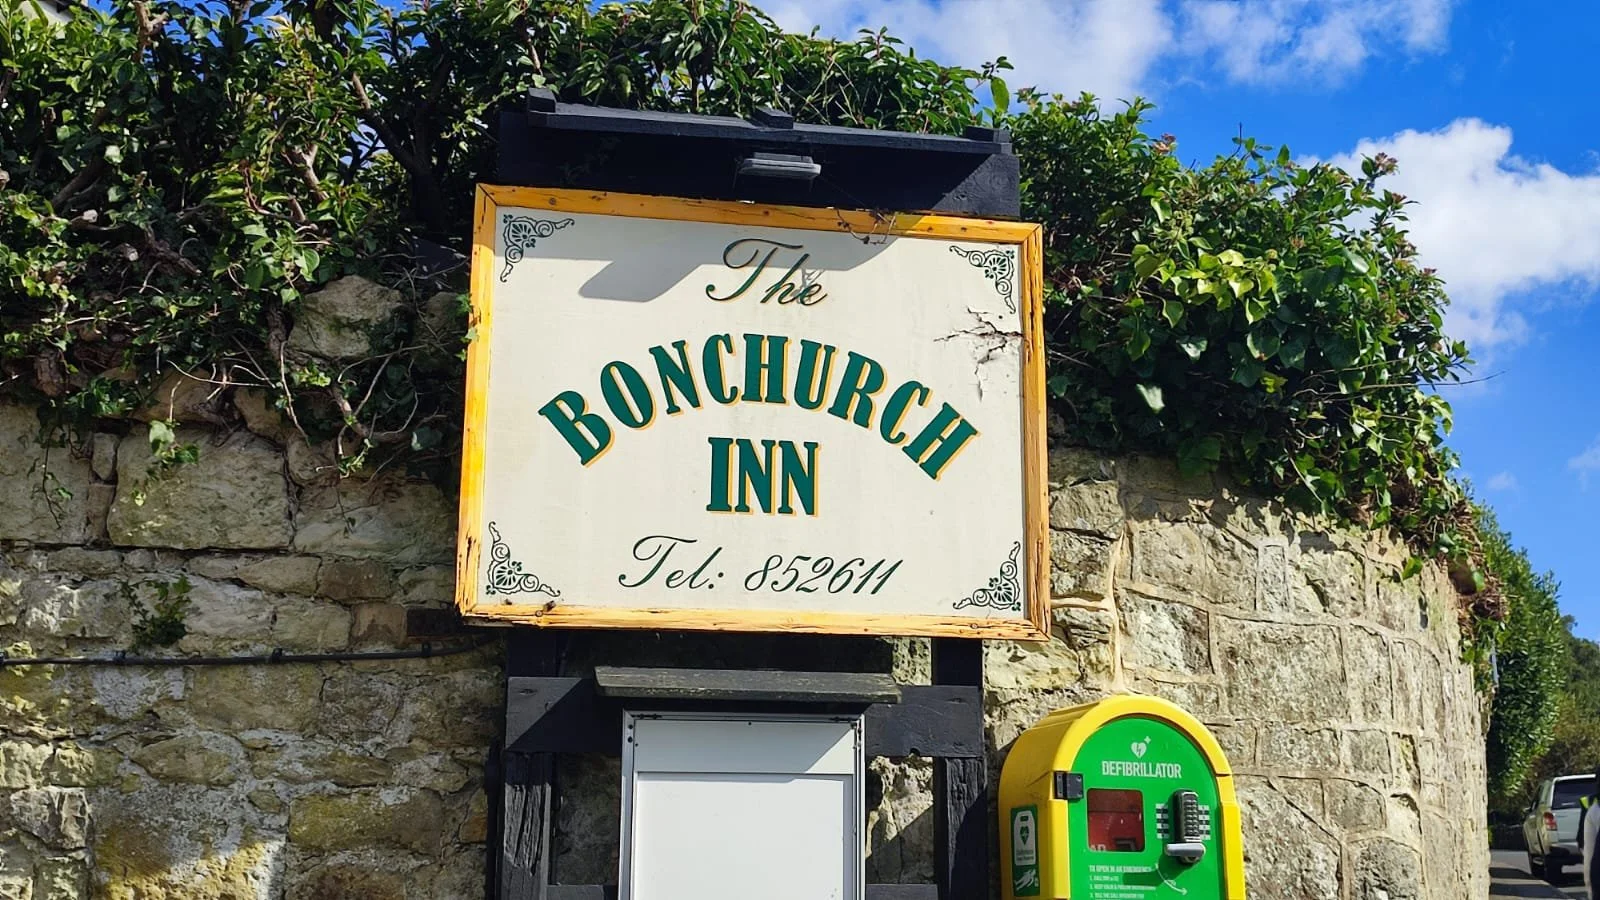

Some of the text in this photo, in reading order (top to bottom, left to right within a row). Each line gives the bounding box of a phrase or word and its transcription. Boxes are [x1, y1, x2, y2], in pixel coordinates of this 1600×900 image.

[706, 238, 827, 306] The
[538, 332, 981, 481] BONCHURCH
[706, 436, 820, 517] INN
[619, 535, 904, 595] Tel: 852611
[1101, 760, 1182, 779] DEFIBRILLATOR
